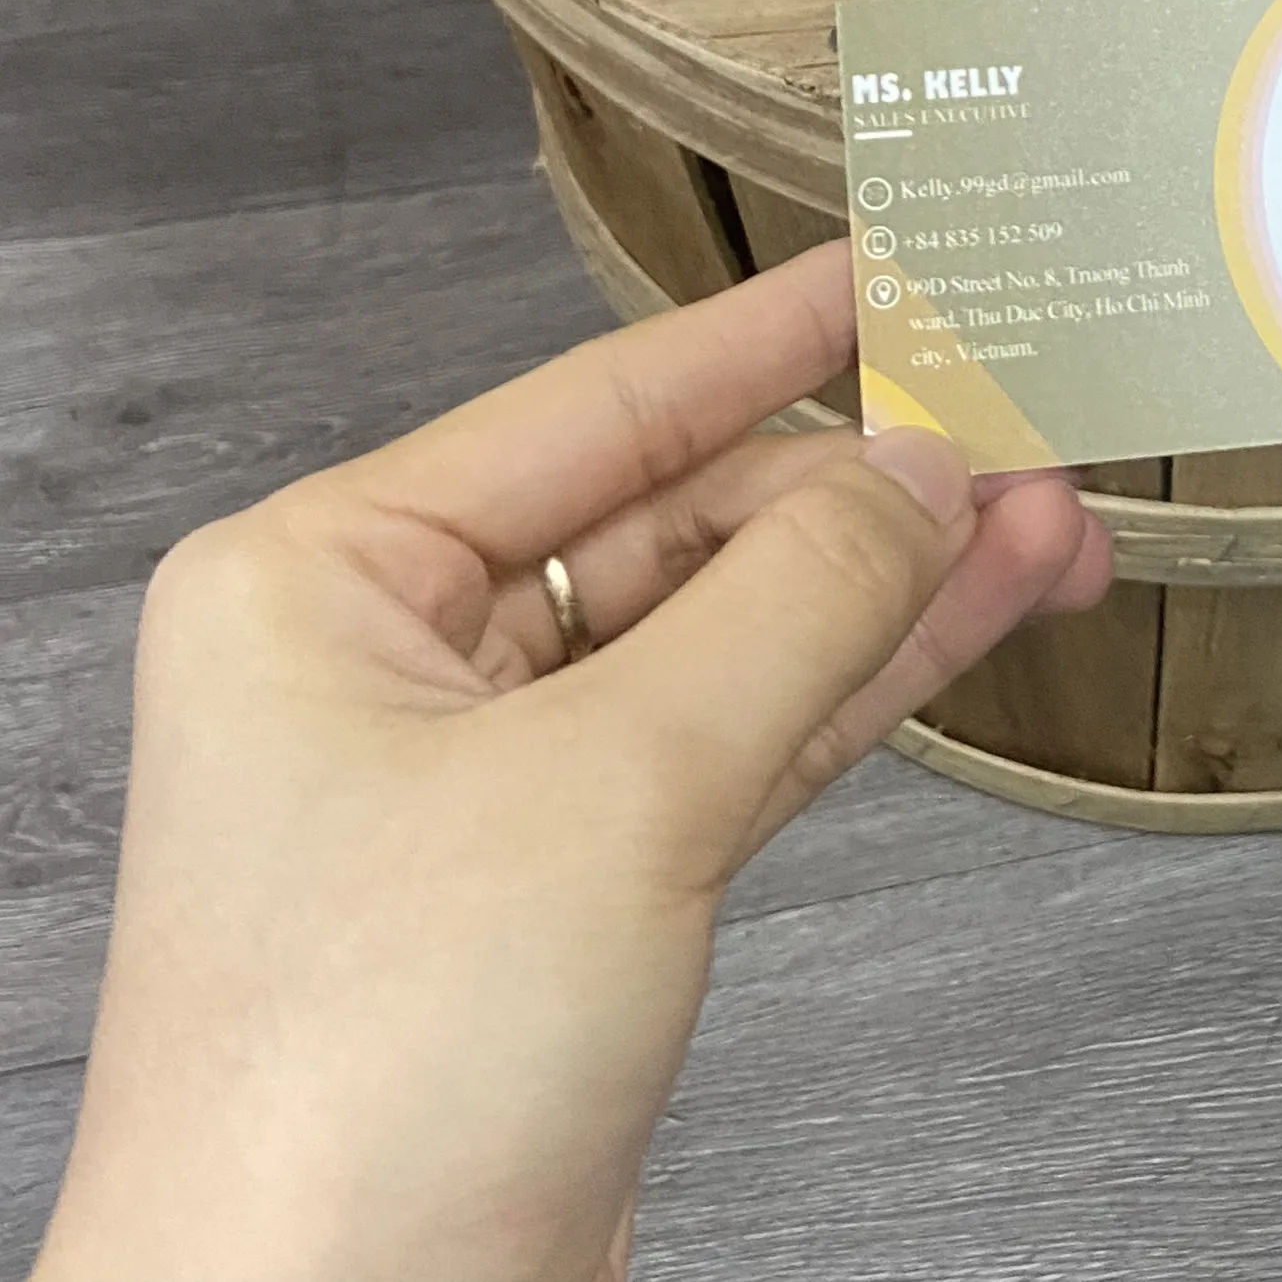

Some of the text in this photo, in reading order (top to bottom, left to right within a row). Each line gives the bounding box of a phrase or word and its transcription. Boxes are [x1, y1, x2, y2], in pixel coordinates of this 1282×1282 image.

[852, 65, 1023, 104] MS. KELLY
[920, 102, 1032, 125] EXECUTIVE
[900, 168, 1131, 200] Kelly.99gd@gmail.com
[903, 221, 1063, 250] +84 835 152 509
[906, 276, 947, 296] 99D
[950, 273, 1002, 295] Street
[1067, 264, 1131, 286] Truong
[1135, 258, 1191, 280] Thanh
[965, 308, 1002, 328] Thu
[1005, 304, 1044, 324] Duc
[1095, 296, 1124, 316] Ho
[1126, 293, 1159, 313] Chi
[1163, 289, 1210, 310] Minh
